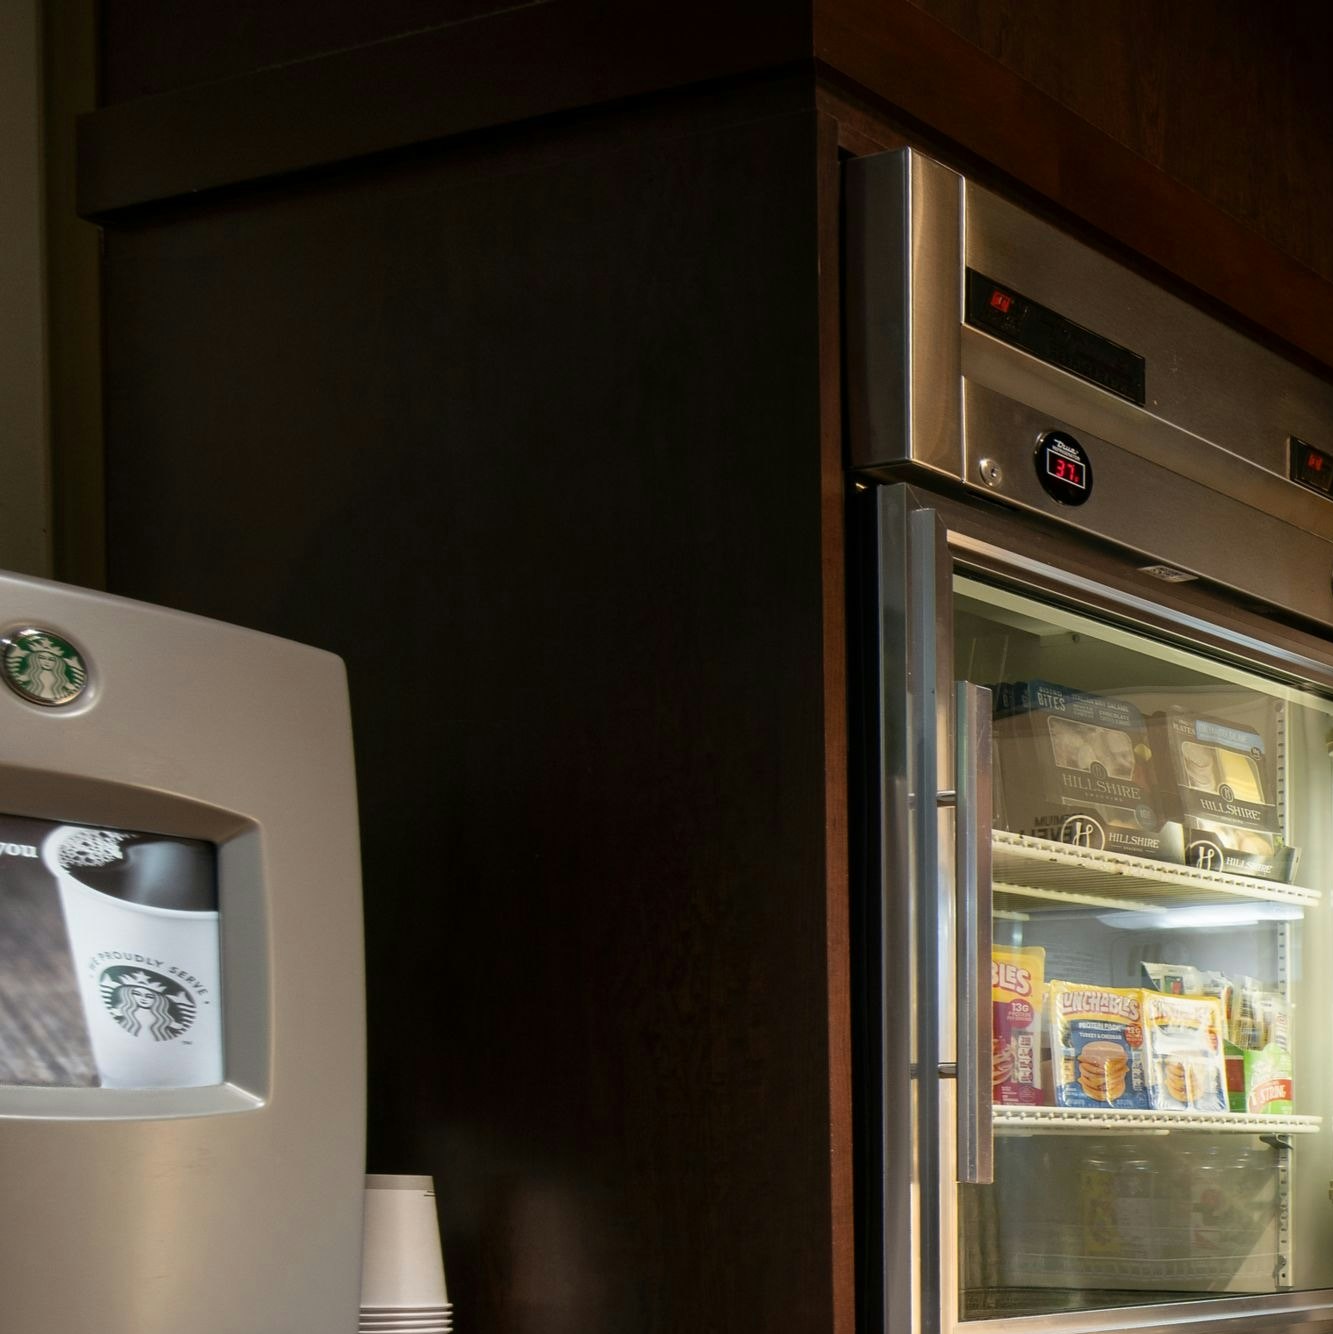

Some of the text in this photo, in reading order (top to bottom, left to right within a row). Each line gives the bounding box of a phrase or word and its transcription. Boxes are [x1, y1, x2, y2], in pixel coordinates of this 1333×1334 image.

[1062, 773, 1142, 800] HILLSHIRE
[1199, 798, 1262, 821] HILLSHIRE
[1108, 831, 1161, 849] HILLSHIRE
[1225, 855, 1273, 874] HILLSHIRE
[98, 951, 165, 969] PROUDLY
[168, 965, 210, 997] SERVE
[1012, 1002, 1030, 1013] 13G
[1061, 990, 1141, 1022] LUNCHABLES
